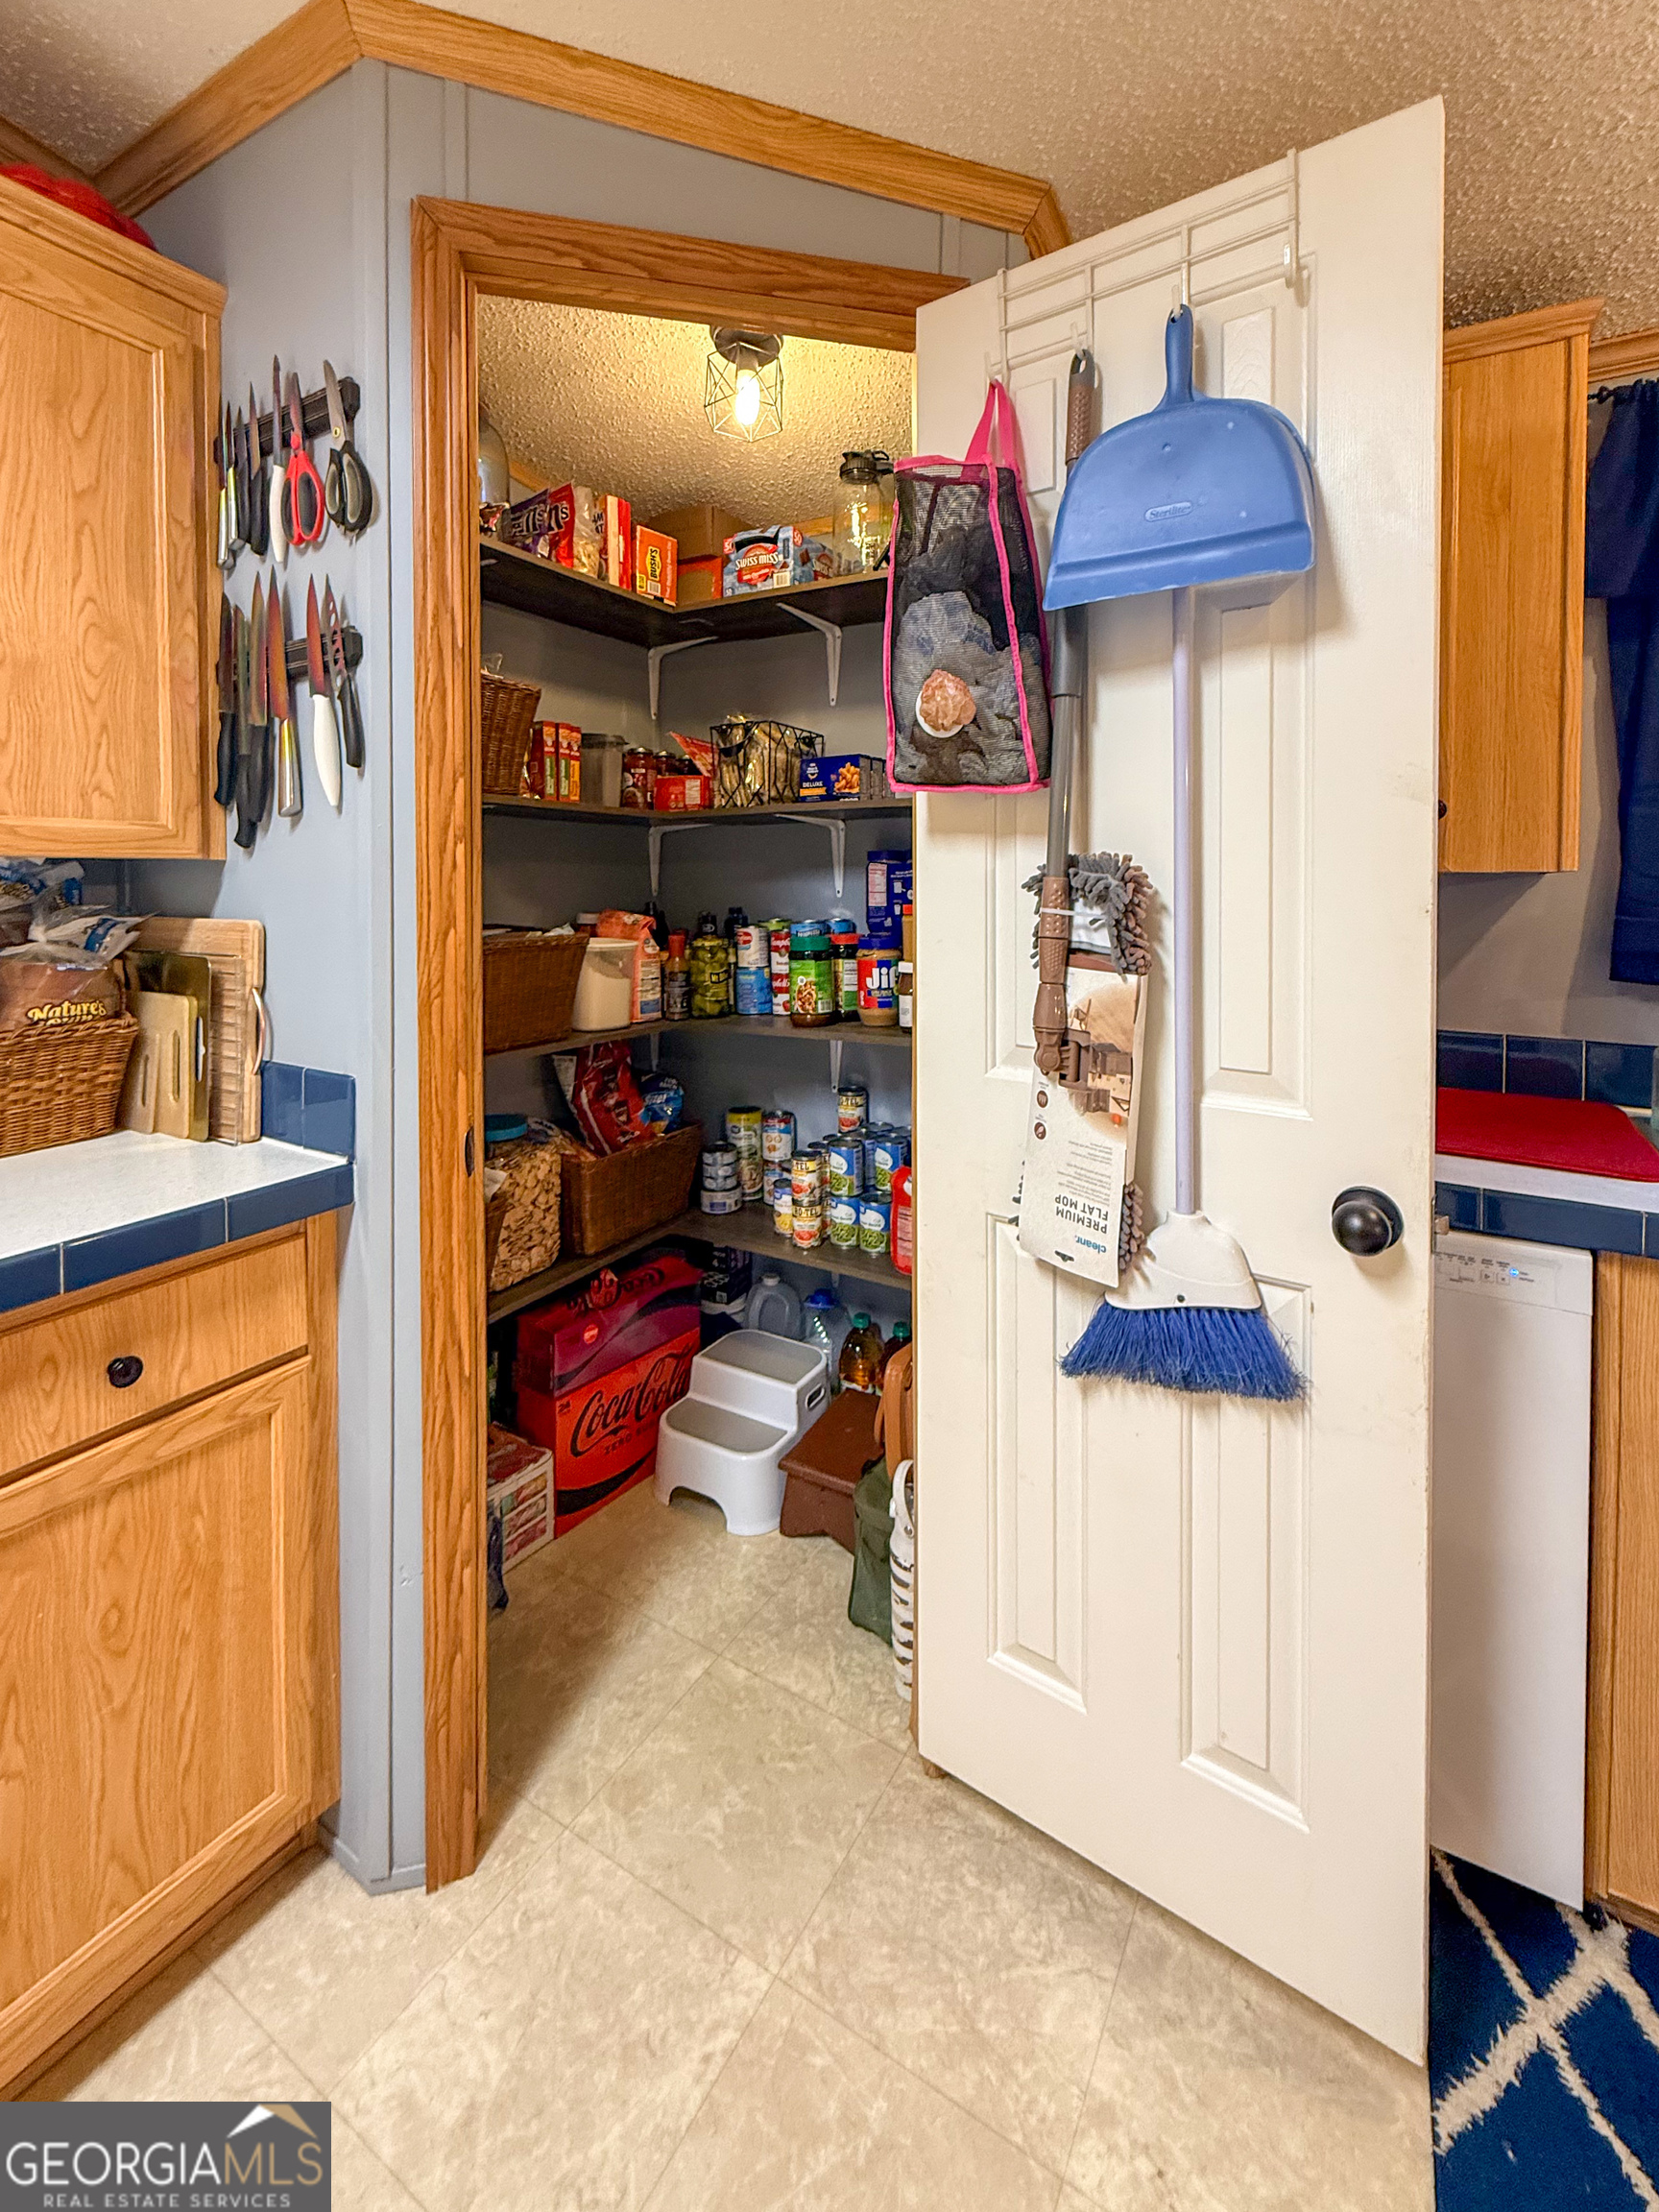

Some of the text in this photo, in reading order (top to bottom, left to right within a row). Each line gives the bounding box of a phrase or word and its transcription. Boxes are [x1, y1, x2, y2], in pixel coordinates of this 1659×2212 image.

[866, 965, 899, 990] Jif
[27, 999, 108, 1022] Nature's
[1054, 1194, 1108, 1221] FLAT MOP
[1056, 1206, 1108, 1235] PREMIUM
[570, 1342, 693, 1457] Coca-Cola
